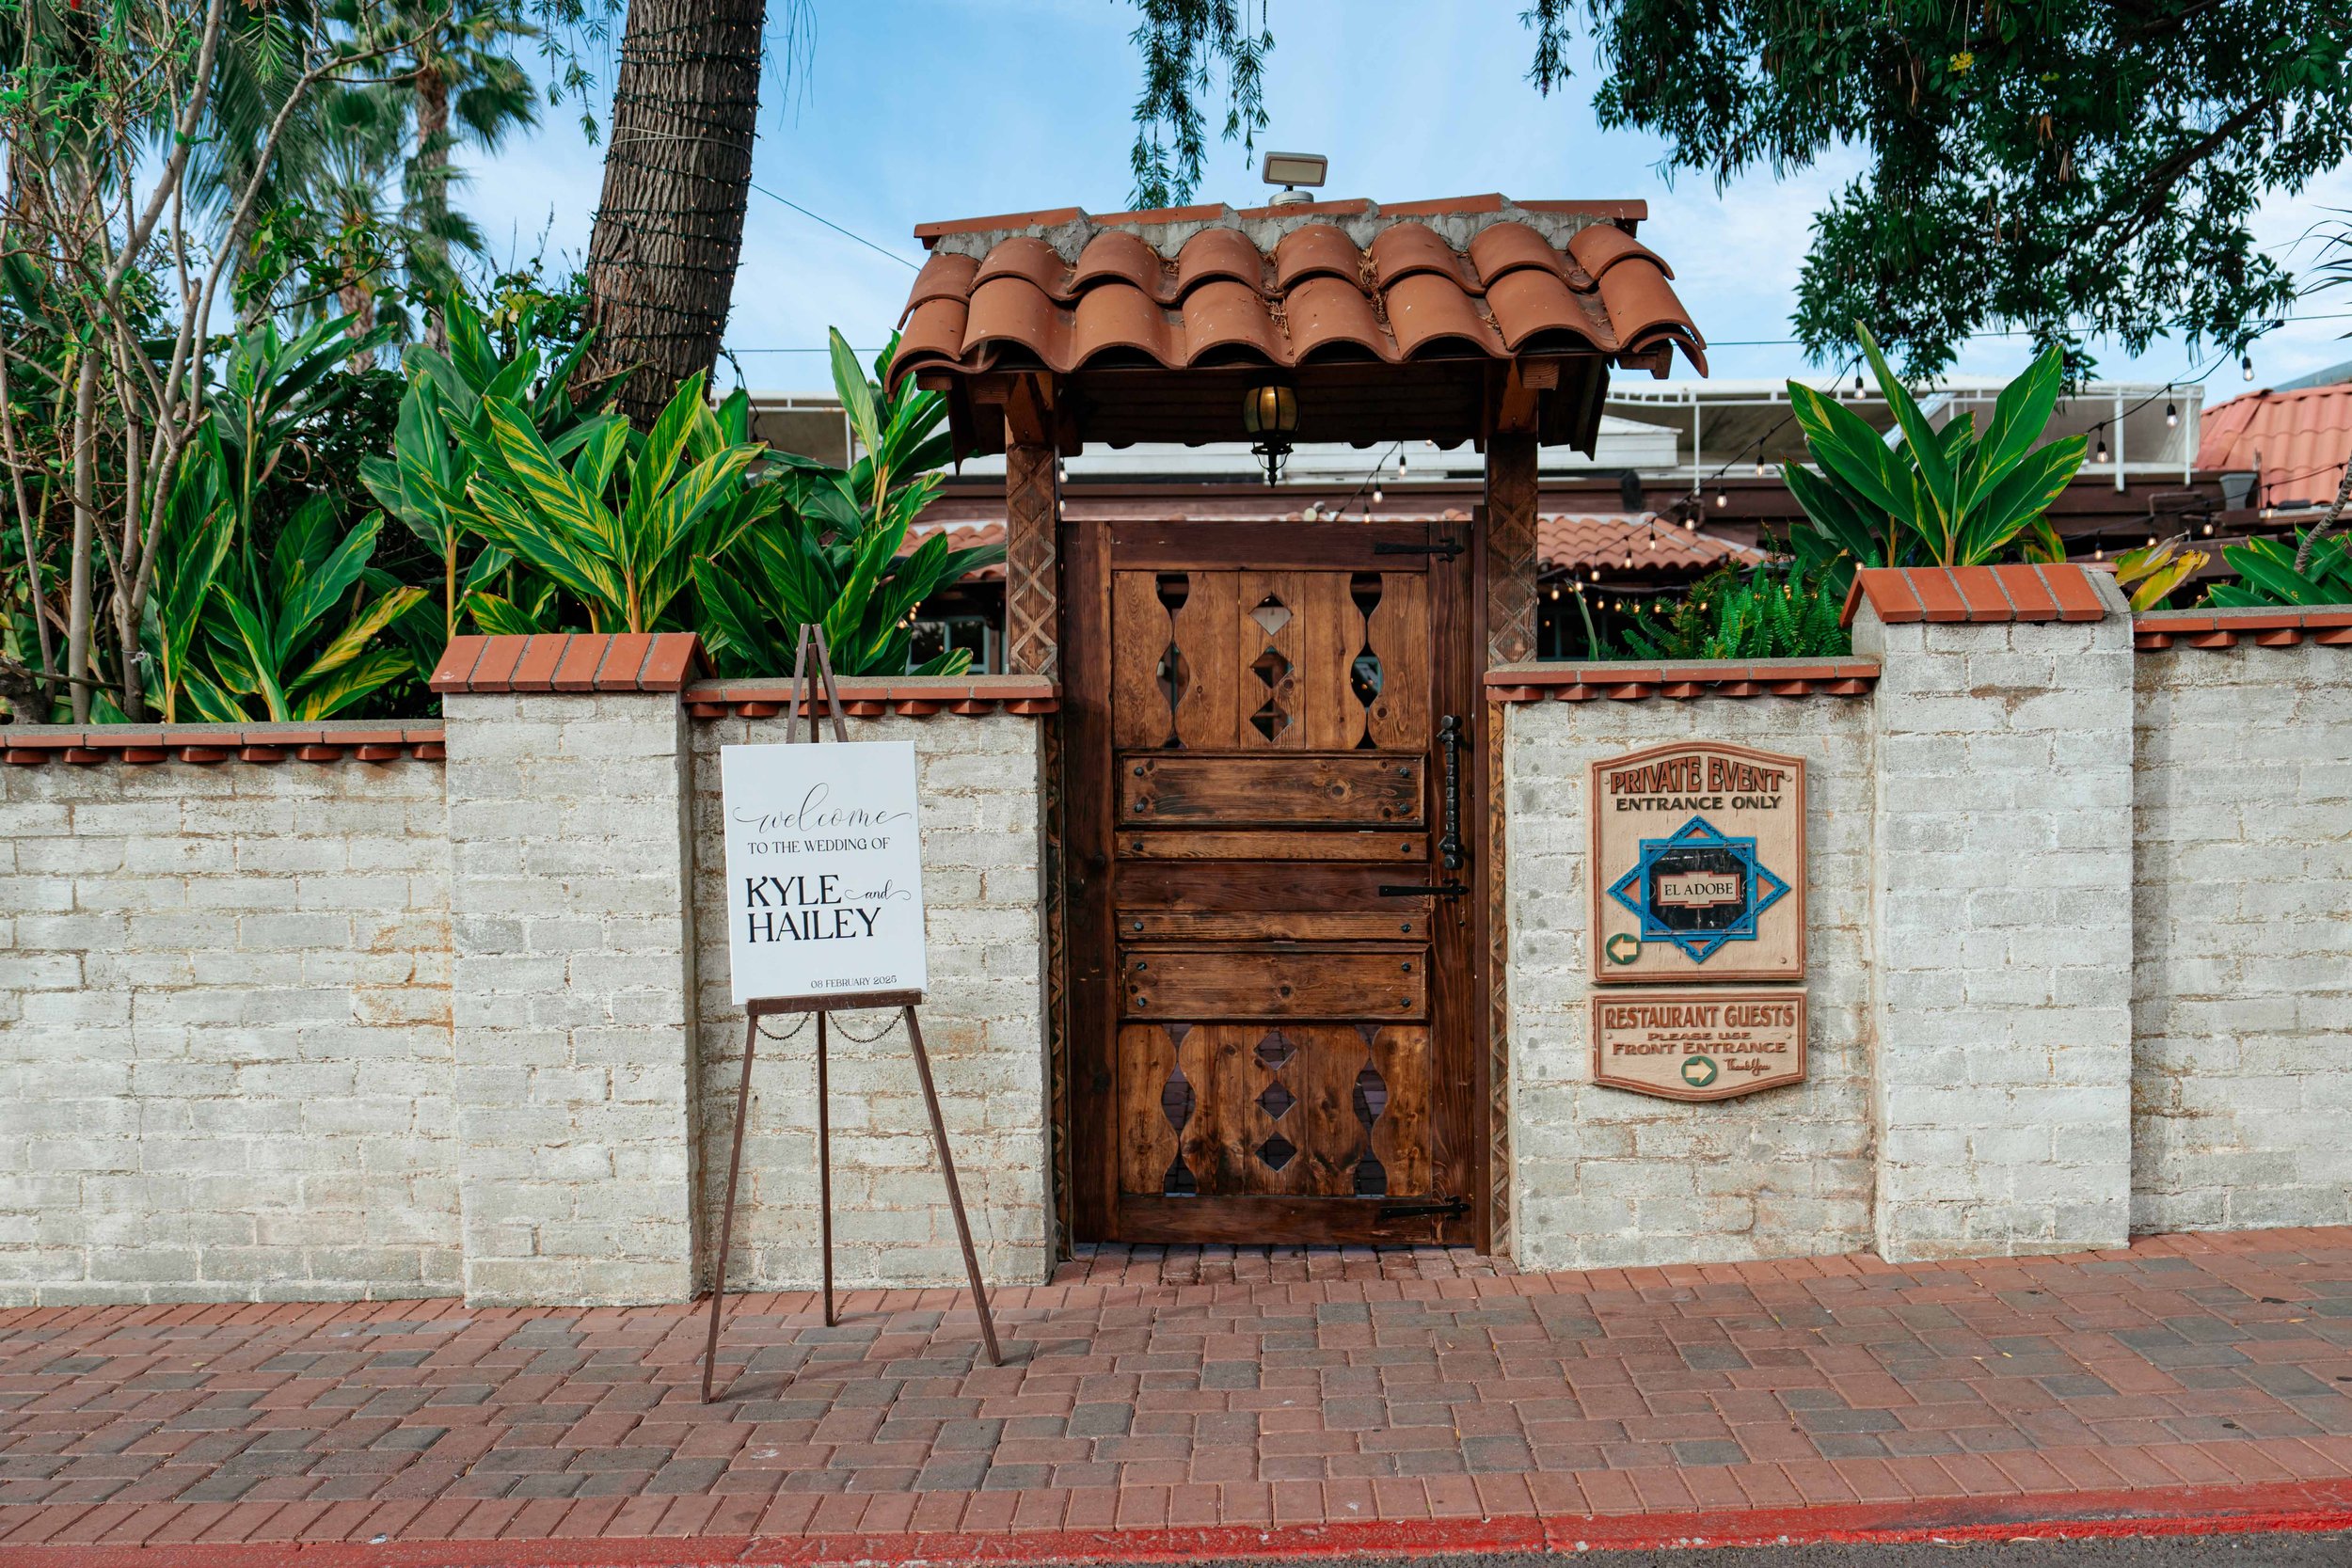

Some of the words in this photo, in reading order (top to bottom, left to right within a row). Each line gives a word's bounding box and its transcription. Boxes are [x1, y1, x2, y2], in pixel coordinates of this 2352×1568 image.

[1611, 756, 1701, 794] PRIVATE
[1708, 756, 1785, 792] EVENT
[733, 783, 912, 833] welcome
[1616, 797, 1724, 811] ENTRANCE
[1732, 796, 1781, 809] ONLY
[748, 842, 768, 854] TO
[772, 841, 800, 853] THE
[804, 838, 867, 851] WEDDING
[871, 837, 890, 849] OF
[746, 875, 842, 908] KYLE
[845, 879, 912, 900] and
[1665, 884, 1680, 895] EL
[1684, 882, 1733, 895] ADOBE
[749, 908, 881, 942] HAILEY
[811, 980, 823, 989] 08
[826, 977, 870, 988] FEBRUARY
[874, 975, 897, 985] 2025
[1605, 1006, 1719, 1029] RESTAURANT
[1724, 1006, 1794, 1027] GUESTS
[1613, 1044, 1677, 1054] FRONT
[1683, 1042, 1787, 1053] ENTRANCE
[1724, 1058, 1751, 1071] Thank
[1751, 1057, 1771, 1075] You
